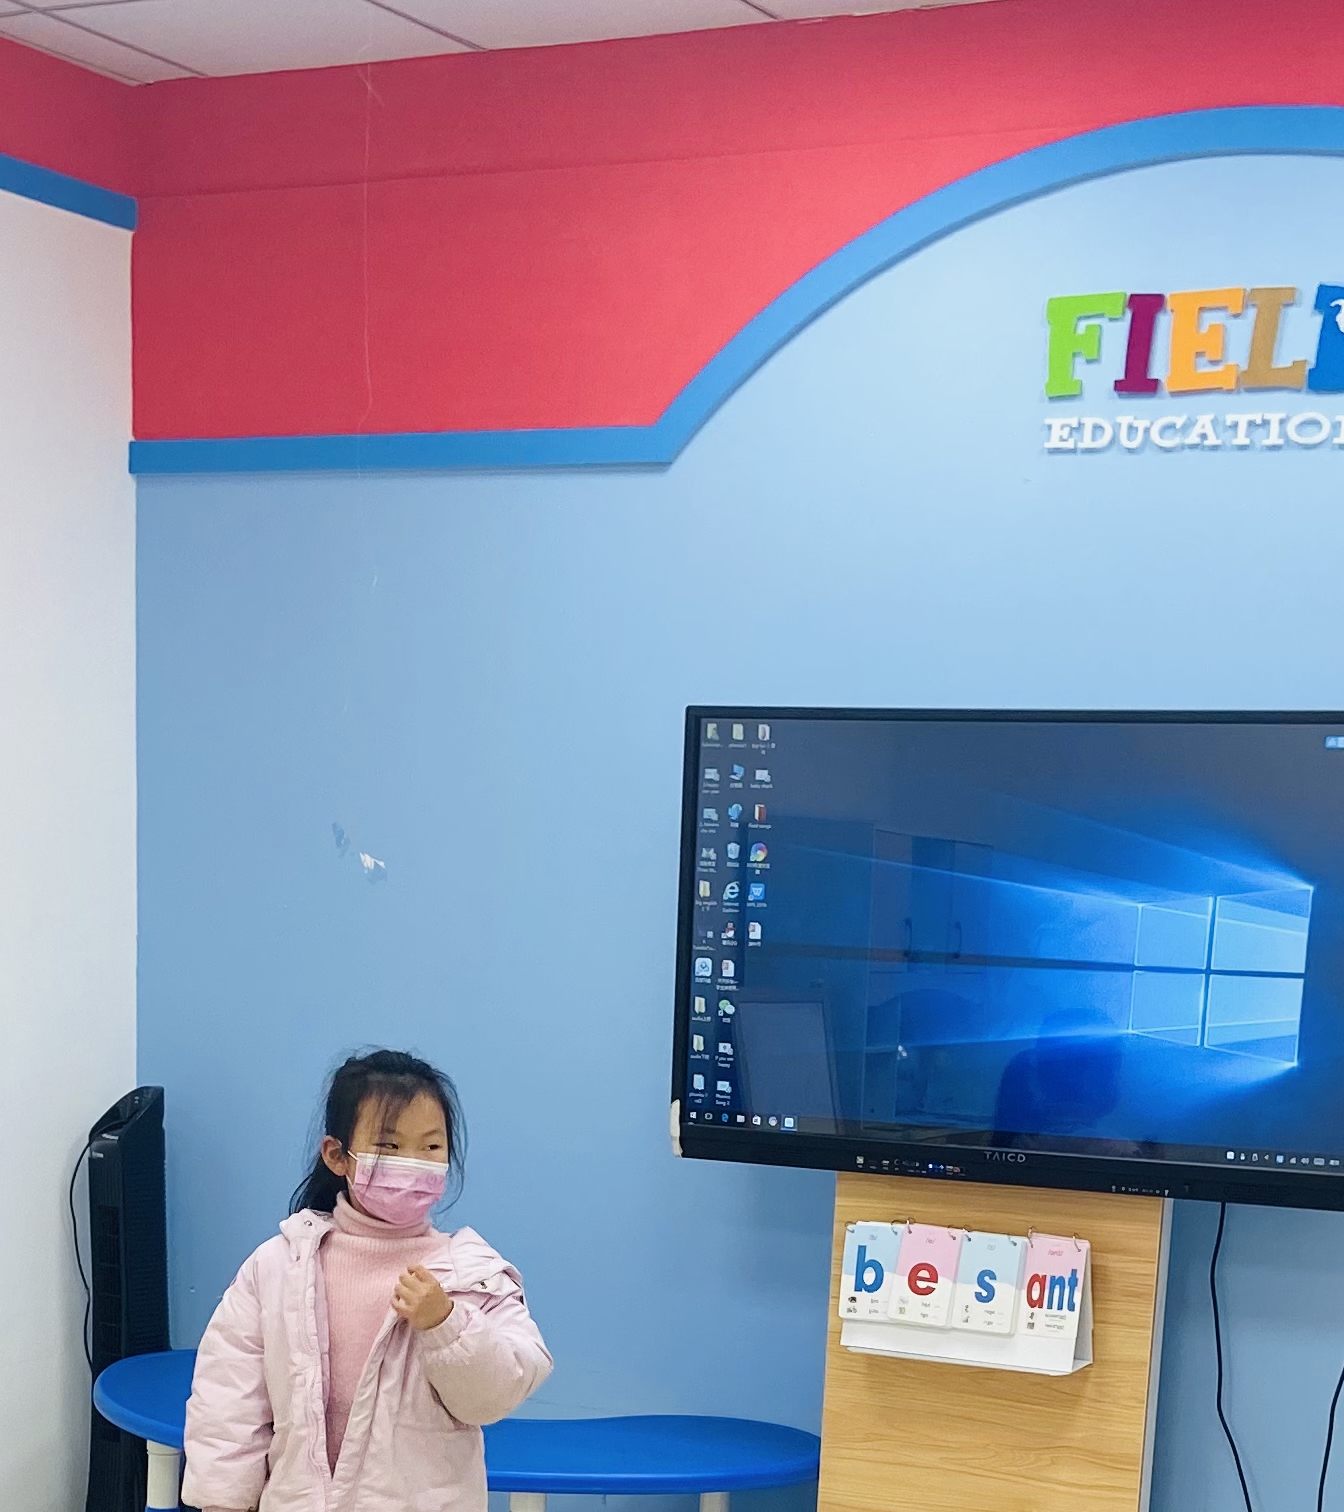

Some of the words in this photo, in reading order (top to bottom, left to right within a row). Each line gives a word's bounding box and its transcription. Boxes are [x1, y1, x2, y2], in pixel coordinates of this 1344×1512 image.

[854, 1245, 885, 1293] b
[908, 1262, 939, 1296] e
[975, 1269, 997, 1303] s
[1026, 1269, 1078, 1312] ant
